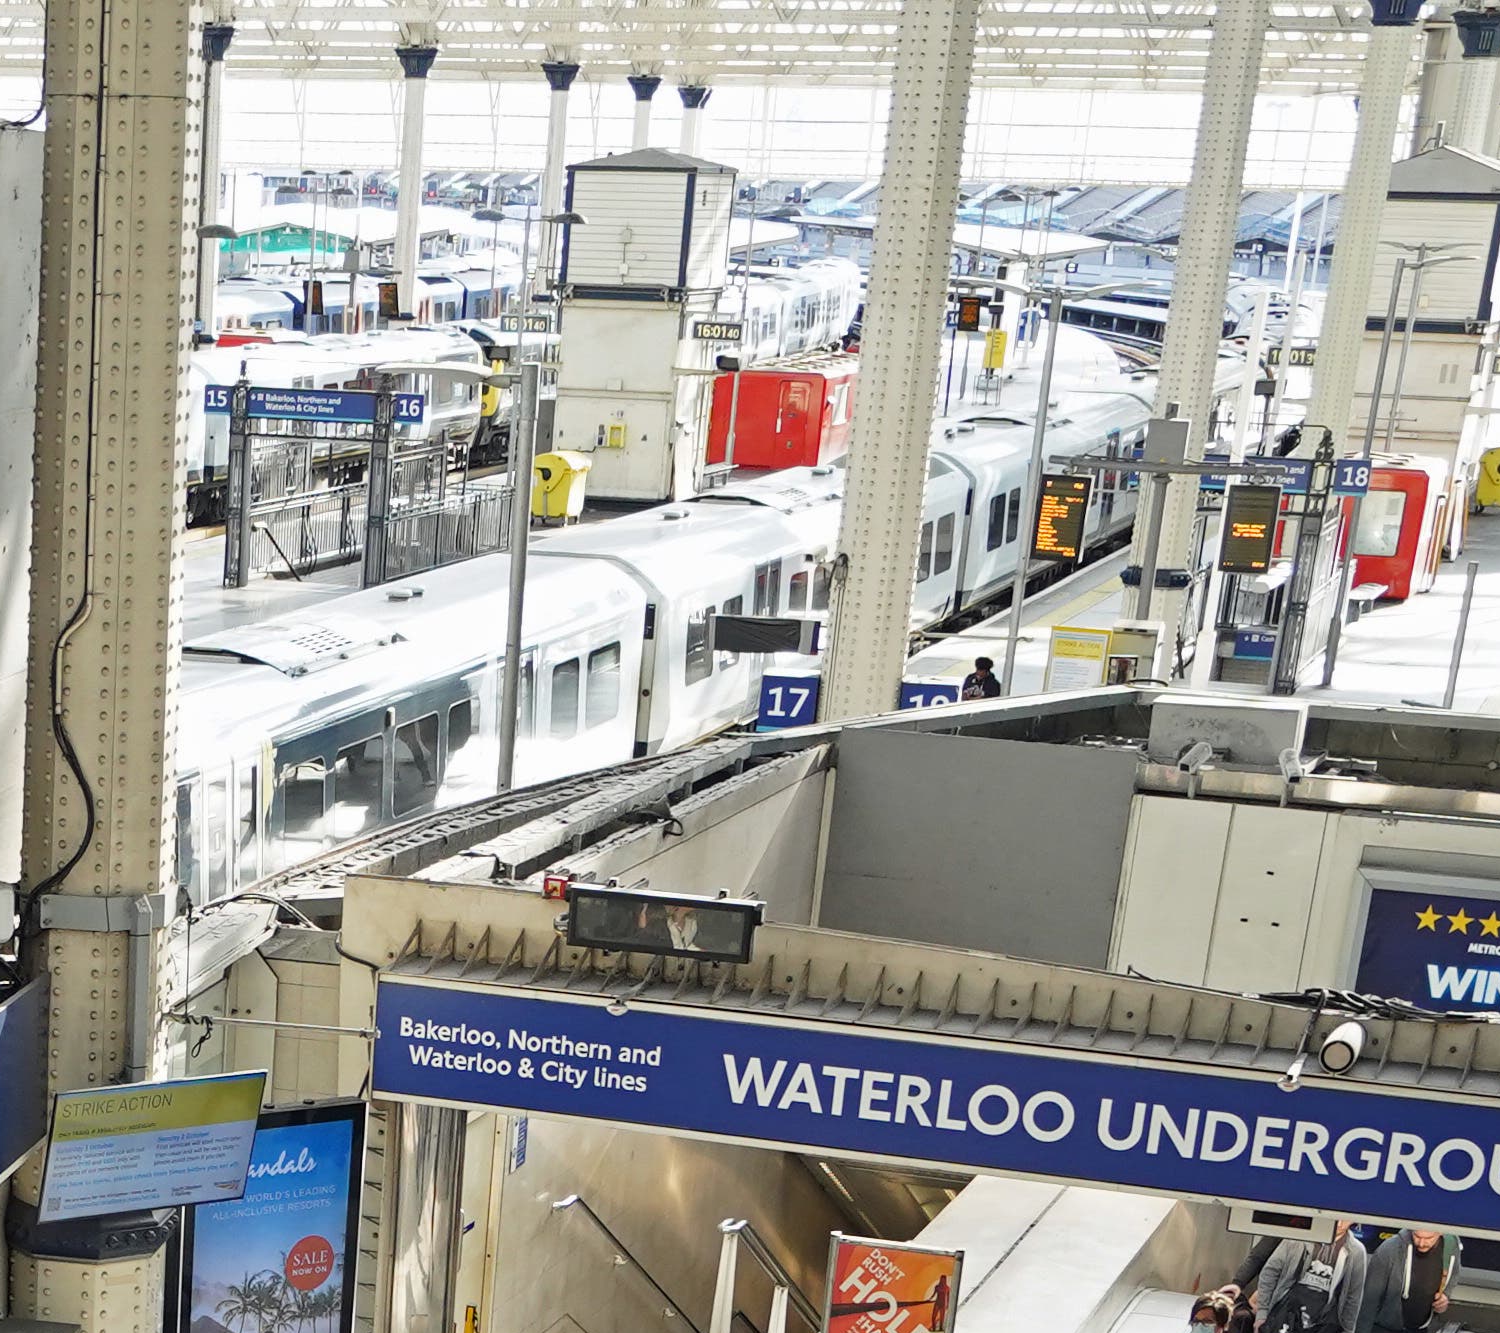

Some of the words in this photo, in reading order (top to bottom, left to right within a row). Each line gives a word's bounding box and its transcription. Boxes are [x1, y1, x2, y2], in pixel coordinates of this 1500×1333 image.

[696, 324, 726, 338] 16:01
[727, 329, 740, 338] 40
[207, 390, 228, 407] 15
[265, 402, 296, 411] Waterloo
[303, 405, 317, 414] City
[297, 396, 327, 405] Northern
[328, 397, 342, 405] and
[399, 399, 420, 416] 16
[1342, 466, 1367, 487] 18
[767, 687, 809, 717] 17
[399, 1016, 501, 1049] Bakerloo,
[507, 1029, 612, 1060] Northern
[618, 1046, 661, 1067] and
[409, 1044, 512, 1077] Waterloo
[517, 1057, 534, 1078] &
[541, 1060, 588, 1089] City
[593, 1067, 647, 1092] lines
[62, 1102, 114, 1118] STRIKE
[117, 1093, 172, 1112] ACTION
[722, 1051, 1075, 1143] WATERLOO
[247, 1147, 318, 1180] andals
[247, 1188, 291, 1202] WORLD'S
[293, 1183, 336, 1198] LEADING
[212, 1204, 284, 1220] ALL-INCLUSIVE
[287, 1199, 331, 1212] RESORTS
[293, 1249, 328, 1266] SALE
[870, 1249, 905, 1281] DON'T
[292, 1266, 314, 1277] NOW
[316, 1265, 328, 1275] ON
[862, 1257, 893, 1285] RUSH
